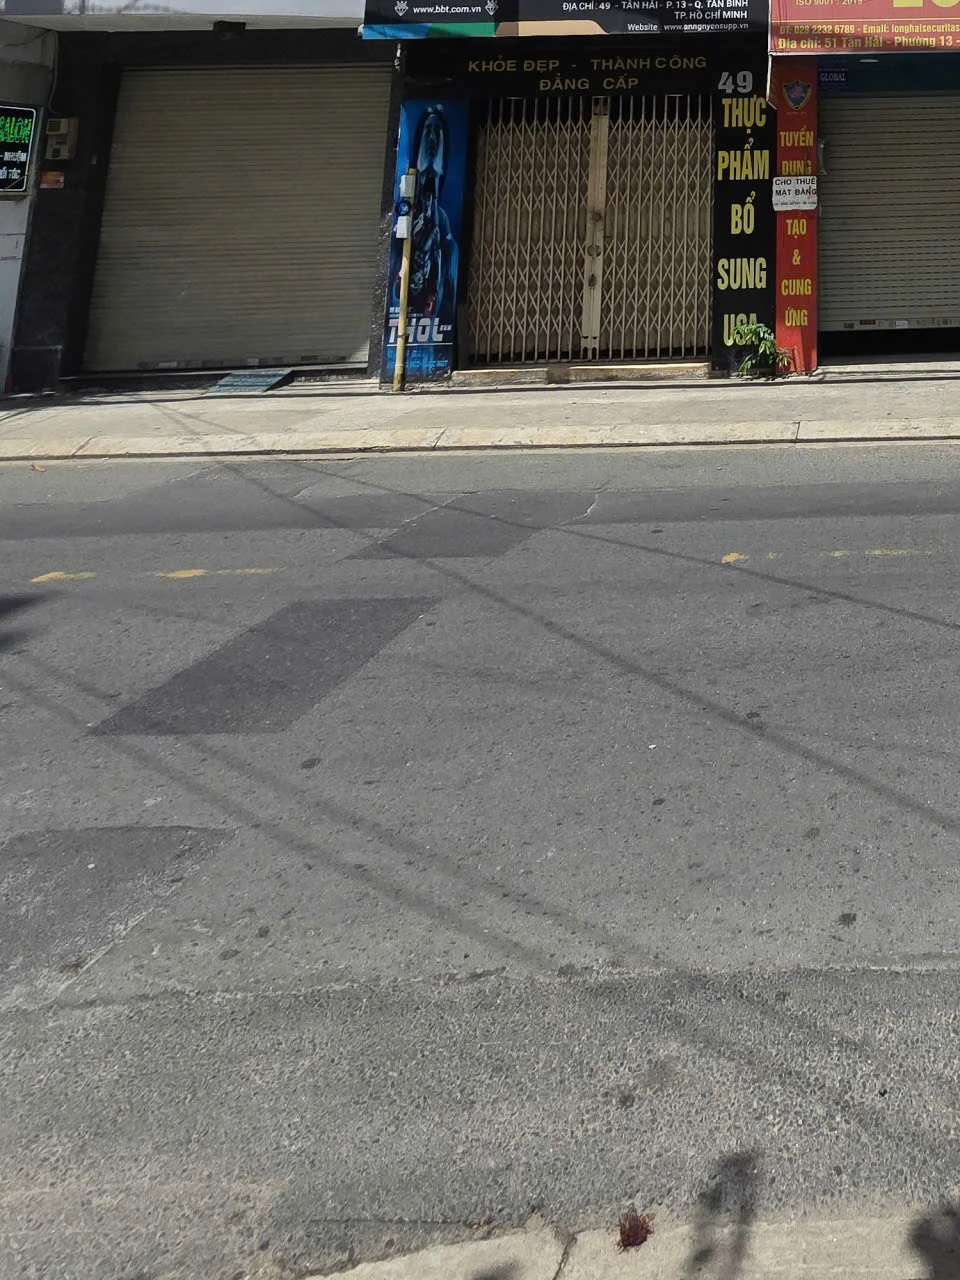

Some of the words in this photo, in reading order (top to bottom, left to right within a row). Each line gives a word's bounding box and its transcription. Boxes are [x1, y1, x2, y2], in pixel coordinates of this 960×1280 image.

[412, 5, 482, 14] www.bbt.com.vn
[562, 1, 578, 12] ĐỊA
[598, 2, 611, 10] 49
[621, 0, 640, 10] TÂN
[675, 0, 687, 9] 13
[694, 0, 704, 10] Q.
[689, 9, 703, 20] HỒ
[704, 8, 721, 20] CHÍ
[722, 9, 748, 19] MINH
[811, 24, 833, 34] 2232
[834, 24, 856, 33] 6789
[862, 24, 890, 33] Email:
[824, 38, 837, 48] 51
[842, 36, 862, 48] Tân
[893, 35, 937, 48] Phường
[939, 35, 954, 46] 13
[467, 54, 518, 72] KHỎE
[523, 59, 560, 73] ĐẸP
[591, 55, 651, 71] THÀNH
[655, 54, 707, 69] CÔNG
[538, 72, 590, 91] ĐẲNG
[602, 72, 639, 90] CẤP
[717, 70, 753, 94] 49
[820, 72, 847, 81] GLOBAL
[721, 94, 767, 134] THỰC
[779, 125, 814, 147] TUYỂN
[717, 137, 770, 181] PHẨM
[774, 178, 792, 186] CHO
[796, 177, 816, 185] THUÊ
[730, 191, 755, 235] BỔ
[786, 218, 807, 239] TẠO
[792, 249, 801, 266] &
[717, 257, 767, 291] SUNG
[781, 279, 812, 296] CUNG
[784, 306, 808, 327] ỨNG
